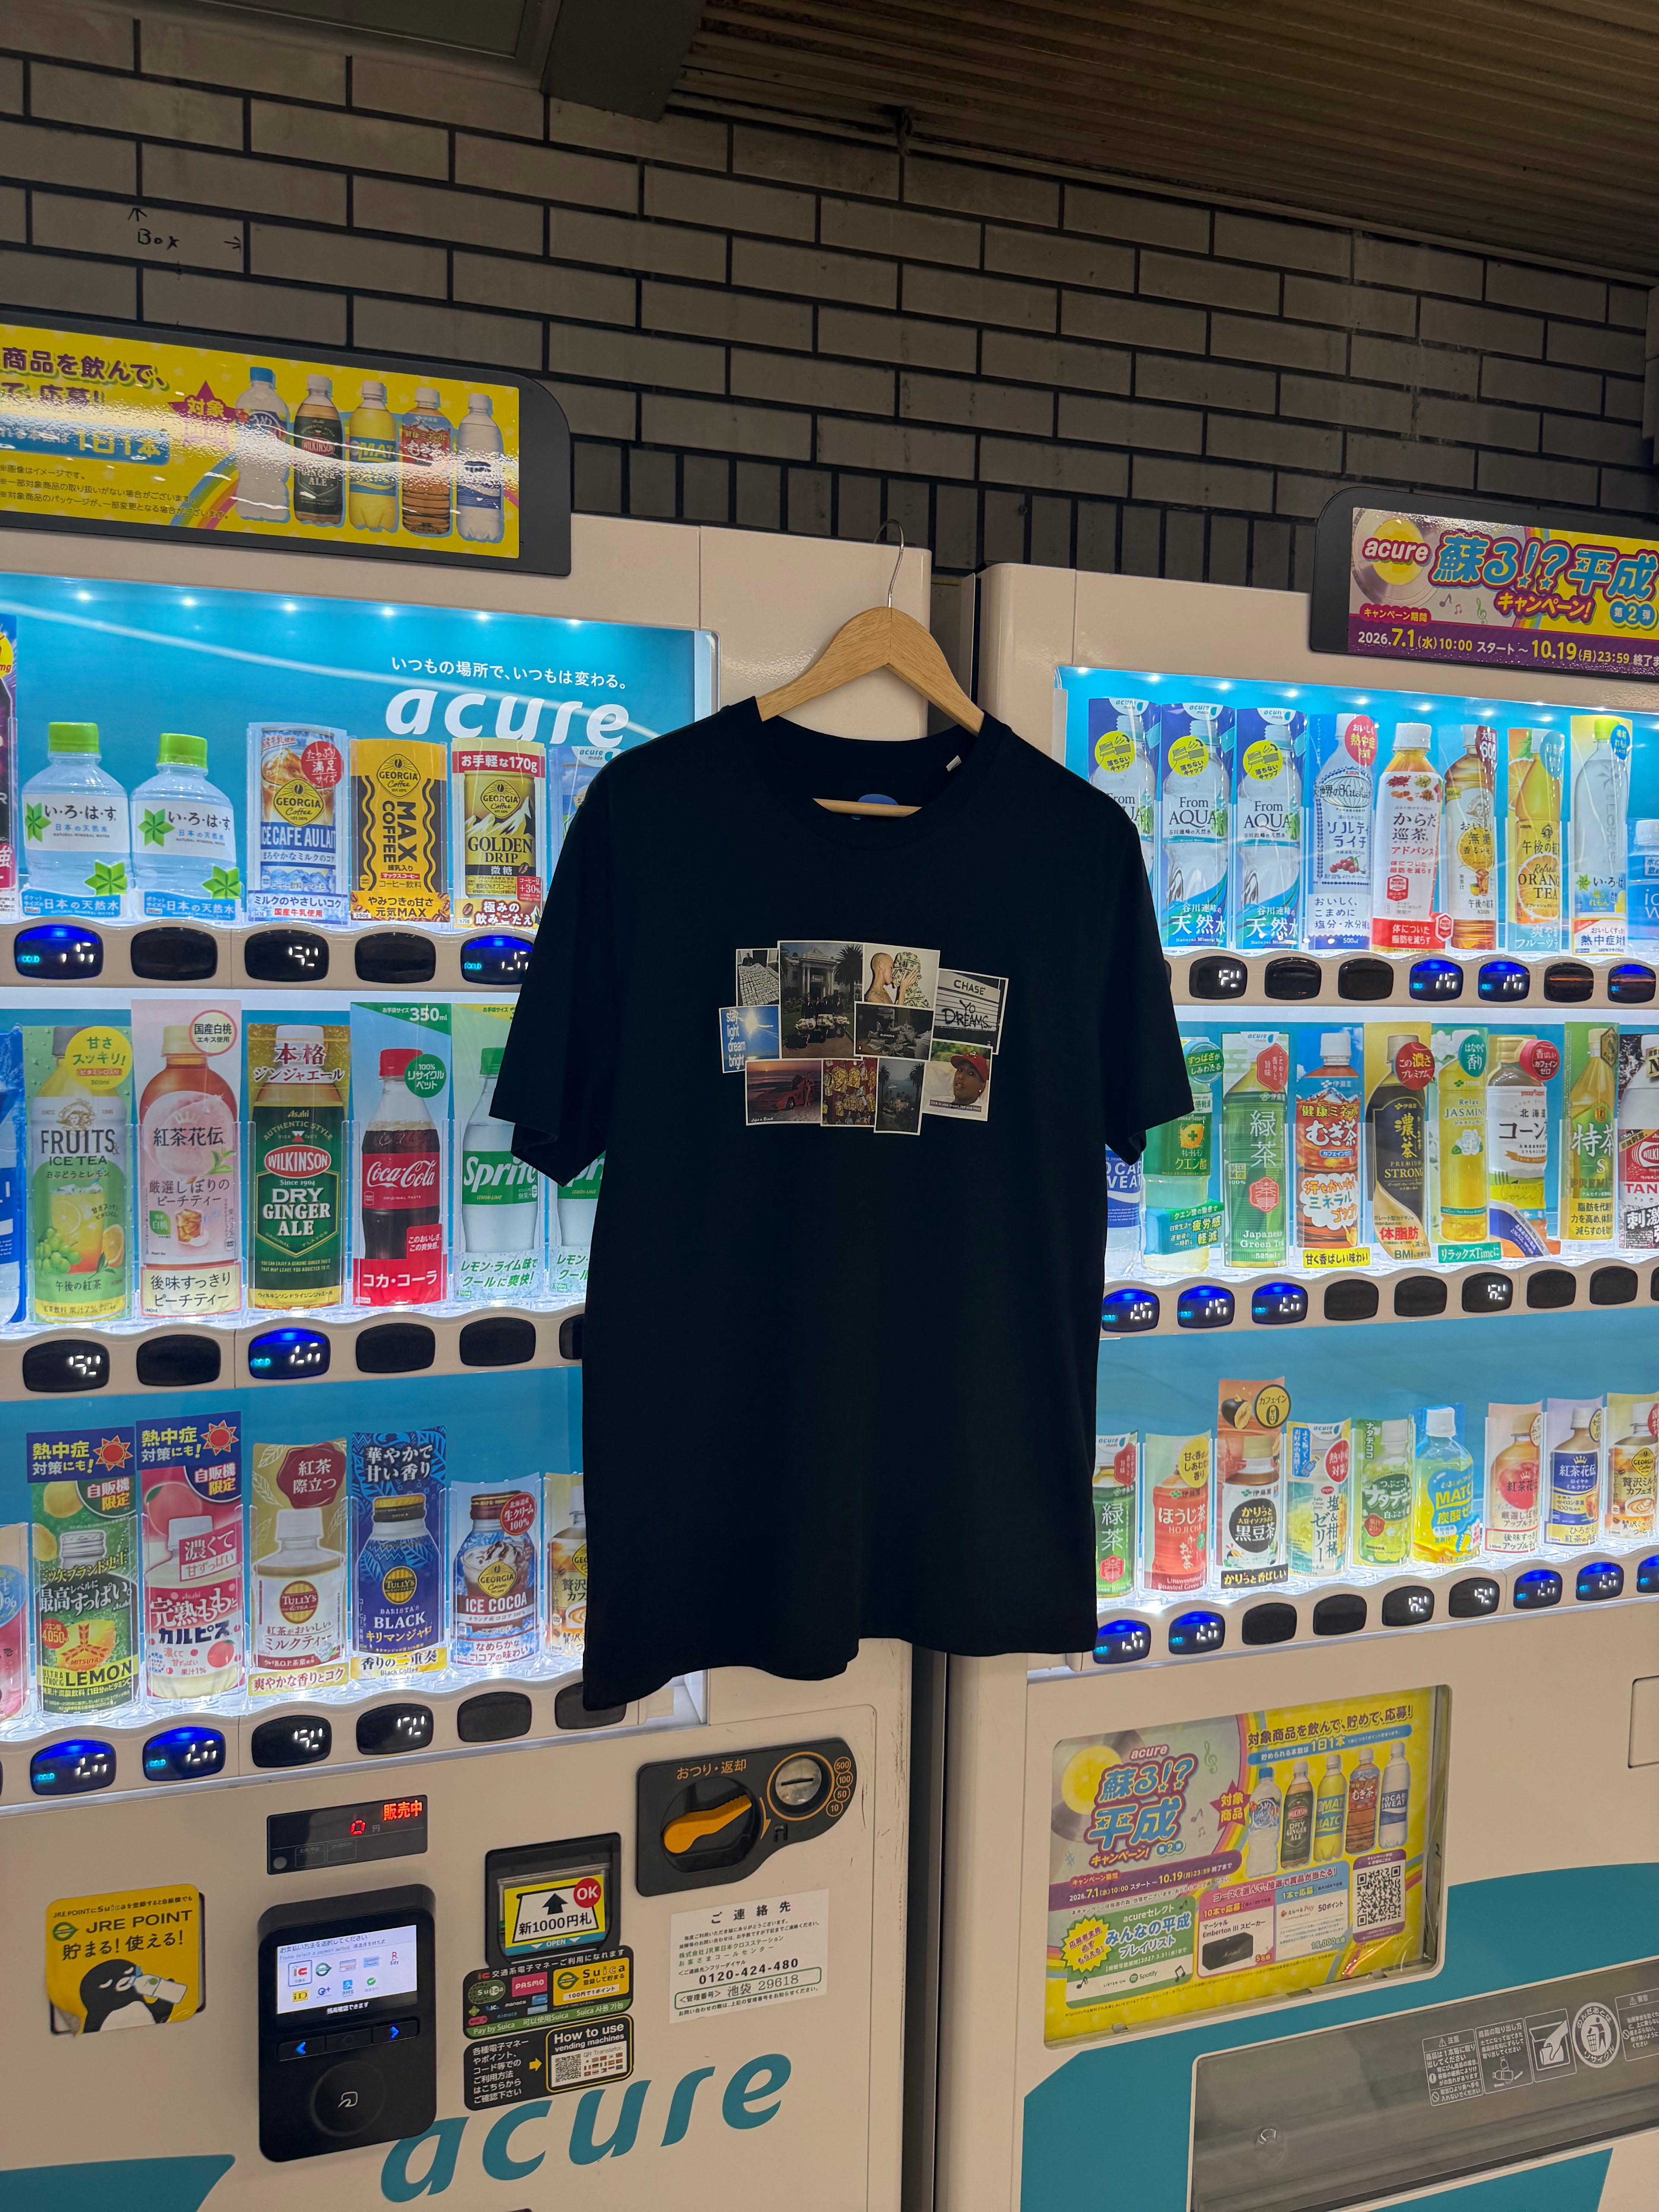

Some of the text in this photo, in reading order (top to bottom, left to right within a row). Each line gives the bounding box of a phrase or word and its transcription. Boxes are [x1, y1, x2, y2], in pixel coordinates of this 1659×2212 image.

[138, 229, 179, 250] Box
[188, 398, 224, 417] 対象
[1365, 539, 1430, 561] acure
[1568, 550, 1659, 600] 平成
[1497, 592, 1593, 619] キャンペーン!
[391, 657, 626, 690] いつもの場所で、いつもは変わる。
[385, 689, 629, 748] acure
[307, 748, 336, 760] たっぷり
[313, 761, 334, 773] 満足
[461, 755, 537, 773] お手軽な170g
[379, 771, 419, 779] GEORGIA
[276, 798, 321, 807] GEORGIA
[1179, 797, 1209, 808] From
[1169, 810, 1216, 828] AQUA
[1392, 812, 1437, 827] からだ
[55, 823, 108, 833] 日本の天然水
[383, 801, 395, 863] COFFEE
[397, 801, 417, 863] MAX
[1392, 827, 1426, 841] 巡茶
[468, 836, 533, 854] GOLDEN
[485, 852, 518, 863] DRIP
[490, 866, 512, 875] 微糖
[254, 896, 341, 908] ミルクのやさしいコク
[368, 896, 434, 907] やみつきの甘さ
[274, 909, 322, 918] 国産牛乳使用
[376, 907, 426, 918] 元気MAX
[475, 913, 532, 925] 飲みごたえ
[1172, 914, 1226, 936] 天然水
[1392, 924, 1430, 935] 体についた
[1392, 934, 1431, 945] 脂肪を減らす
[953, 979, 985, 996] CHASE
[960, 999, 978, 1014] YO
[726, 1010, 738, 1023] stay
[727, 1024, 740, 1038] light
[275, 1043, 326, 1065] 本格
[728, 1040, 746, 1052] dream
[729, 1054, 744, 1068] bright
[1399, 1053, 1431, 1068] この濃さ
[1466, 1055, 1482, 1071] 香り
[1533, 1059, 1557, 1068] カフェイン
[1402, 1069, 1431, 1079] プレミアム
[41, 1129, 115, 1154] FRUITS
[153, 1127, 224, 1147] 紅茶花伝
[1250, 1110, 1277, 1168] 緑茶
[1305, 1120, 1357, 1147] むぎ茶
[49, 1155, 107, 1166] ICE TEA
[267, 1152, 329, 1171] WILKINSON
[1175, 1157, 1207, 1170] クエン酸
[367, 1160, 438, 1188] Coca-Cola
[1384, 1167, 1424, 1179] STRONG
[271, 1187, 324, 1204] DRY
[263, 1203, 331, 1220] GINGER
[277, 1219, 314, 1236] ALE
[1305, 1251, 1369, 1266] 甘く香ばしい味わい
[1441, 1246, 1500, 1261] リラックスTimeに
[55, 1280, 102, 1291] 午後の紅茶
[151, 1274, 232, 1290] 後味すっきり
[363, 1270, 438, 1288] コカ・コーラ
[1259, 1395, 1287, 1405] カフェイン
[1366, 1422, 1374, 1459] ナタデココ
[32, 1441, 89, 1459] 熱中症
[365, 1445, 433, 1465] 華やかで
[365, 1460, 432, 1482] 甘い香り
[1158, 1502, 1206, 1524] ほうじ茶
[1235, 1522, 1275, 1541] 黒豆茶
[184, 1530, 233, 1561] 濃くて
[480, 1573, 514, 1583] GEORGIA
[282, 1594, 317, 1605] TULLY'S
[466, 1592, 527, 1613] ICE COCOA
[374, 1611, 426, 1629] BLACK
[159, 1620, 231, 1645] カルピス
[365, 1625, 432, 1643] キリマンジャロ
[70, 1658, 99, 1666] MITSUYA
[361, 1649, 437, 1671] 香りの二重奏
[254, 1668, 344, 1692] 爽やかな香りとコク
[1131, 1746, 1168, 1760] acure
[677, 1759, 747, 1780] おつり・返却
[836, 1760, 849, 1769] 500
[838, 1775, 851, 1783] 100
[837, 1790, 847, 1798] 50
[382, 1800, 423, 1821] 販売中
[830, 1804, 839, 1812] 10
[350, 1820, 381, 1836] 0 円
[1088, 1798, 1182, 1850] 平成
[577, 1887, 599, 1900] OK
[1123, 1904, 1175, 1923] acureセレクト
[86, 1910, 193, 1934] JRE POINT
[518, 1912, 592, 1936] 新1000円札
[1105, 1911, 1191, 1946] みんなの平成
[62, 1930, 183, 1961] 貯まる! 使える!
[547, 1938, 566, 1947] OPEN
[1119, 1936, 1176, 1958] プレイリスト
[492, 1948, 625, 1978] 交通系電子マネーご利用になれます
[582, 1964, 626, 1979] Suica
[699, 1958, 798, 1985] 0120-424-480
[1139, 1970, 1158, 1981] Spotify
[515, 1978, 545, 1990] PASMO
[727, 1984, 751, 1998] 池袋
[758, 1974, 799, 1991] 29618
[474, 2021, 515, 2035] Pay by Suica
[554, 2023, 625, 2045] How to use
[473, 2038, 529, 2056] 各種電子マネー
[554, 2033, 625, 2053] vending machines
[473, 2051, 517, 2064] やポイント、
[474, 2059, 521, 2075] コード等での
[474, 2070, 514, 2084] ご利用方法
[474, 2079, 522, 2094] はこちらから
[474, 2088, 522, 2104] ご確認下さい
[381, 2053, 791, 2203] acure
